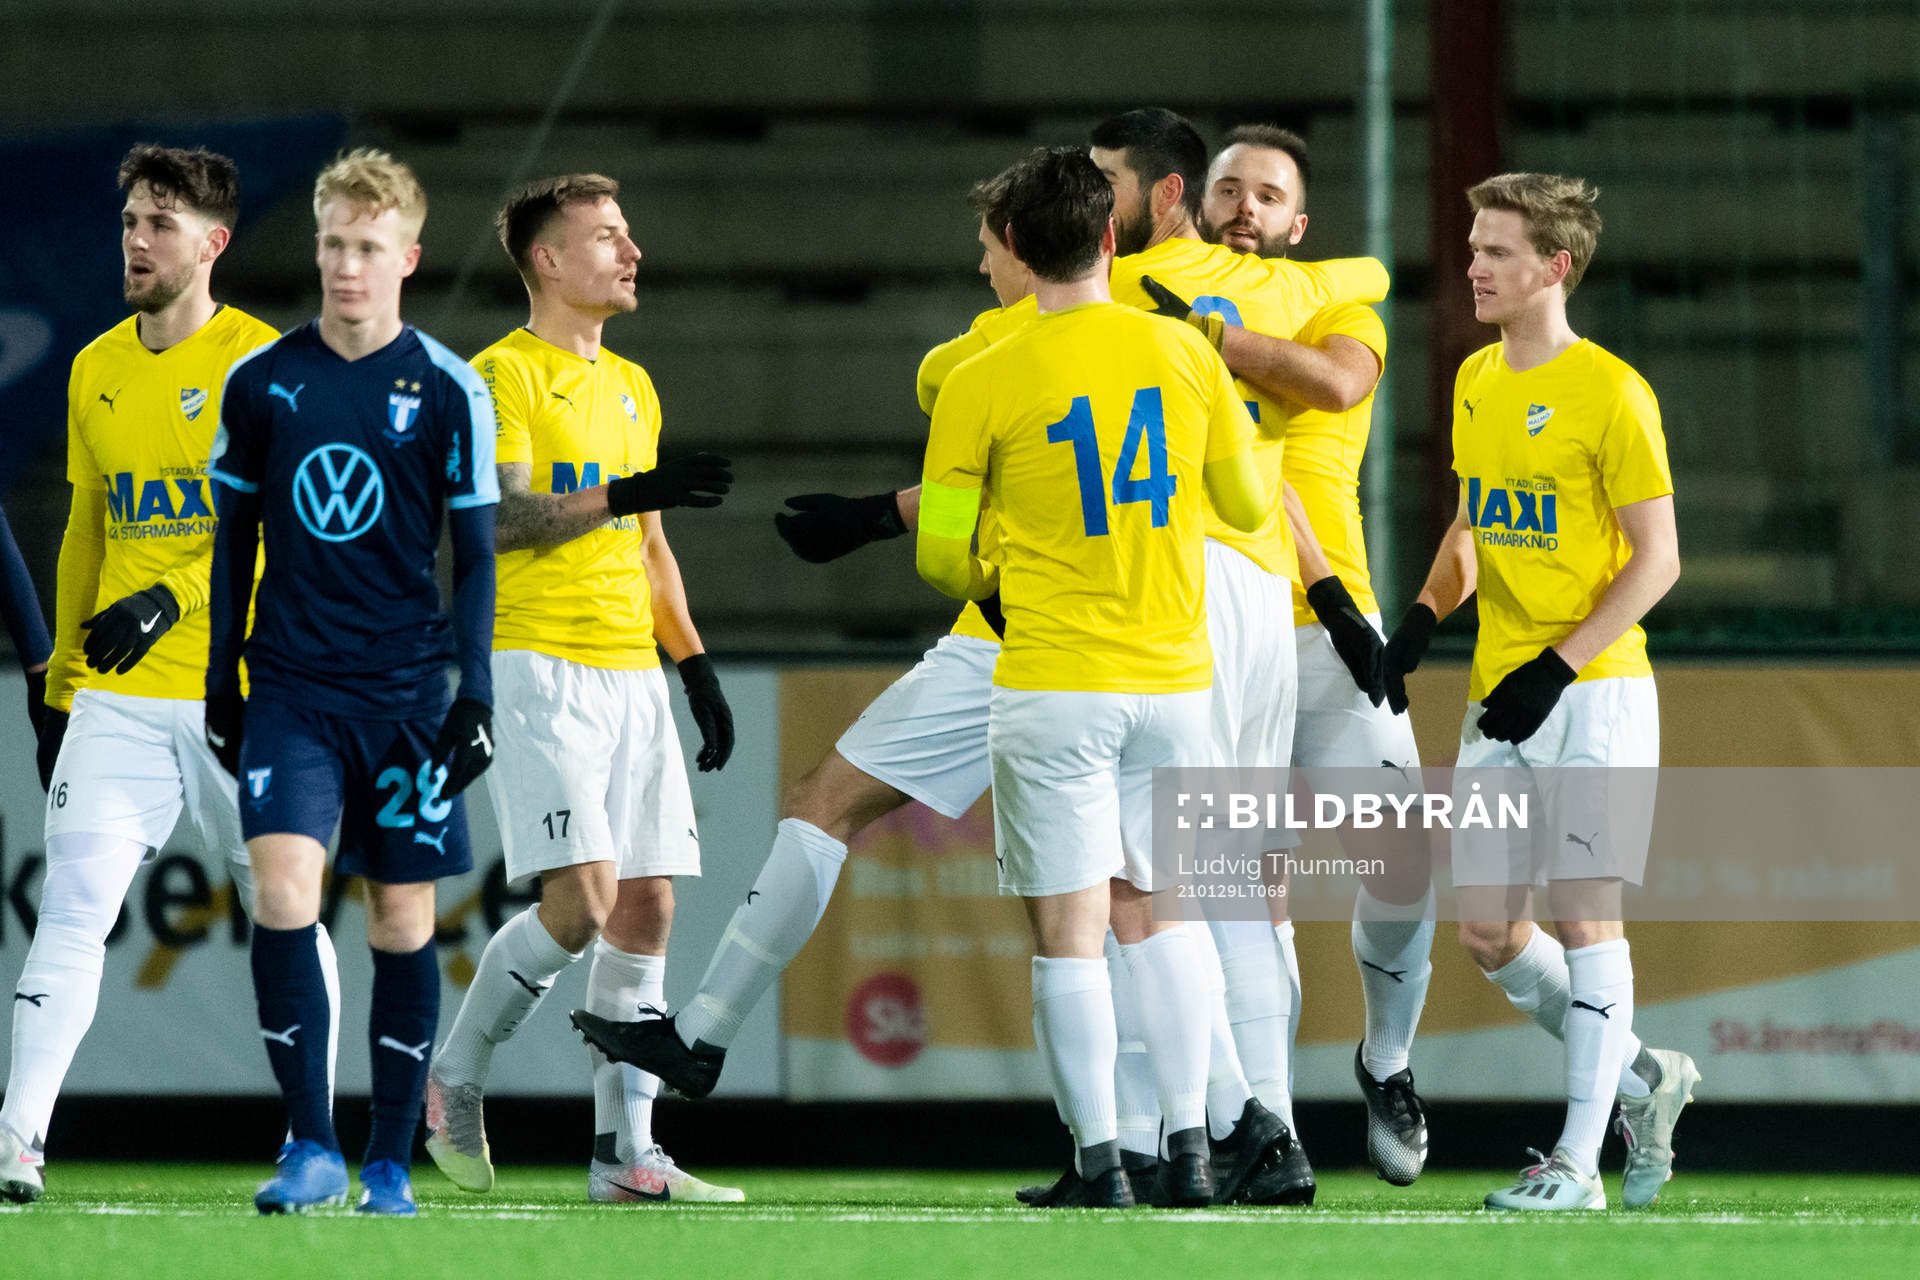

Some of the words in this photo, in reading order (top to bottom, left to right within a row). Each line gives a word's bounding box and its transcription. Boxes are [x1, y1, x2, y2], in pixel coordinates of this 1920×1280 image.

[1046, 386, 1177, 537] 14
[51, 782, 68, 809] 16
[375, 759, 452, 828] 28
[542, 809, 571, 840] 17
